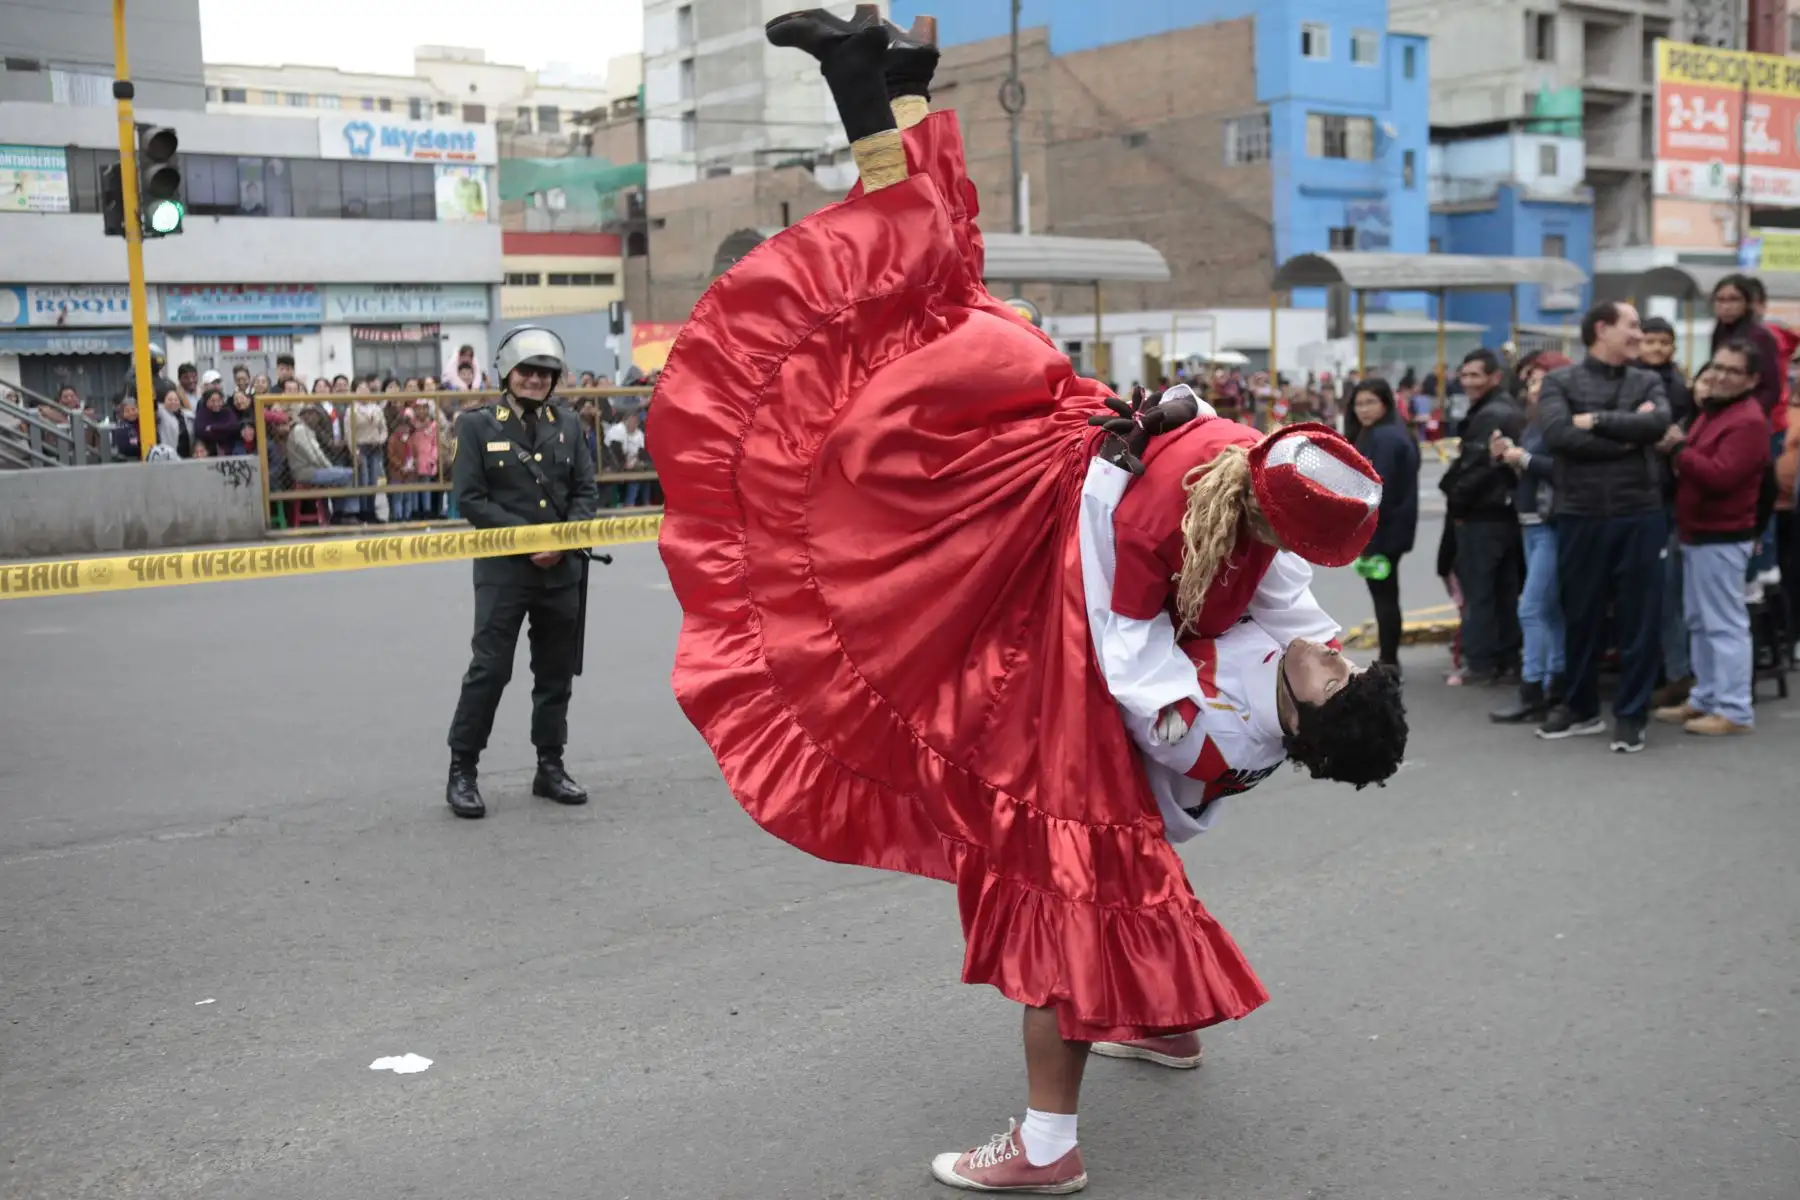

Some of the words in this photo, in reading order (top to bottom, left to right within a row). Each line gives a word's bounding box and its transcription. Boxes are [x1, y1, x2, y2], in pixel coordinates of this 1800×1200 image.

[1668, 48, 1748, 83] PRECIOS
[1756, 60, 1777, 89] DE
[380, 126, 476, 156] Mydent
[35, 285, 129, 298] ORTOPEDI
[35, 299, 128, 313] ROQU
[336, 294, 446, 313] VICENTE
